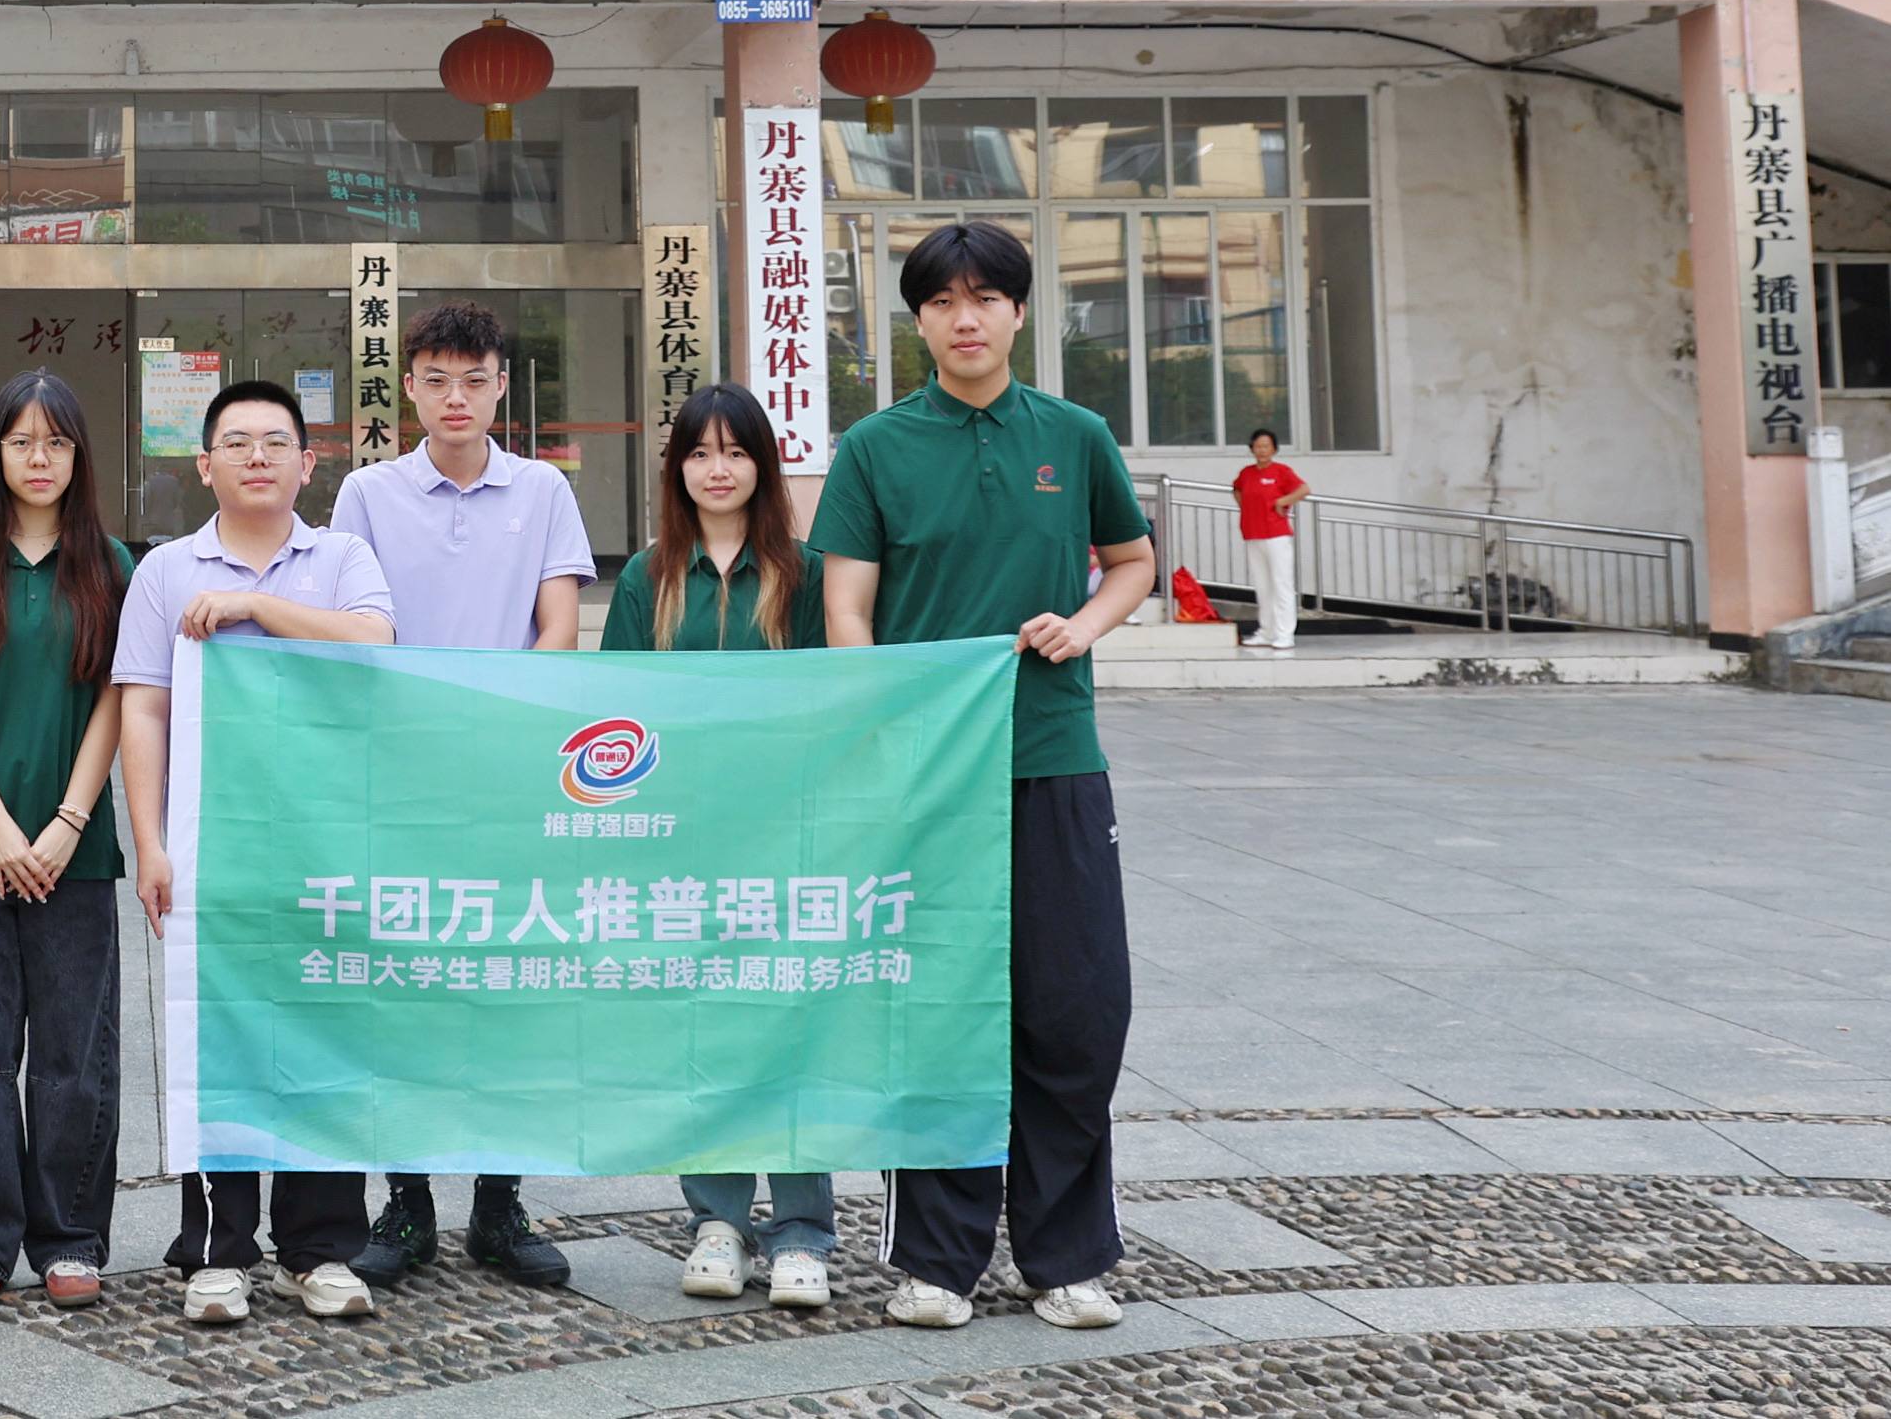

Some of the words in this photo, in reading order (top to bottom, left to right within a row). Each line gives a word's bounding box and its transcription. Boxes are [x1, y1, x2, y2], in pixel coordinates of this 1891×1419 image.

[758, 120, 813, 464] 丹寨县融媒体中心
[1743, 103, 1804, 444] 丹寨县广播电视台
[357, 255, 392, 466] 丹寨县武术
[543, 812, 676, 837] 推普强国行
[298, 872, 915, 943] 千团万人推普强国行
[299, 947, 912, 993] 全国大学生暑期社会实践志愿服务活动
